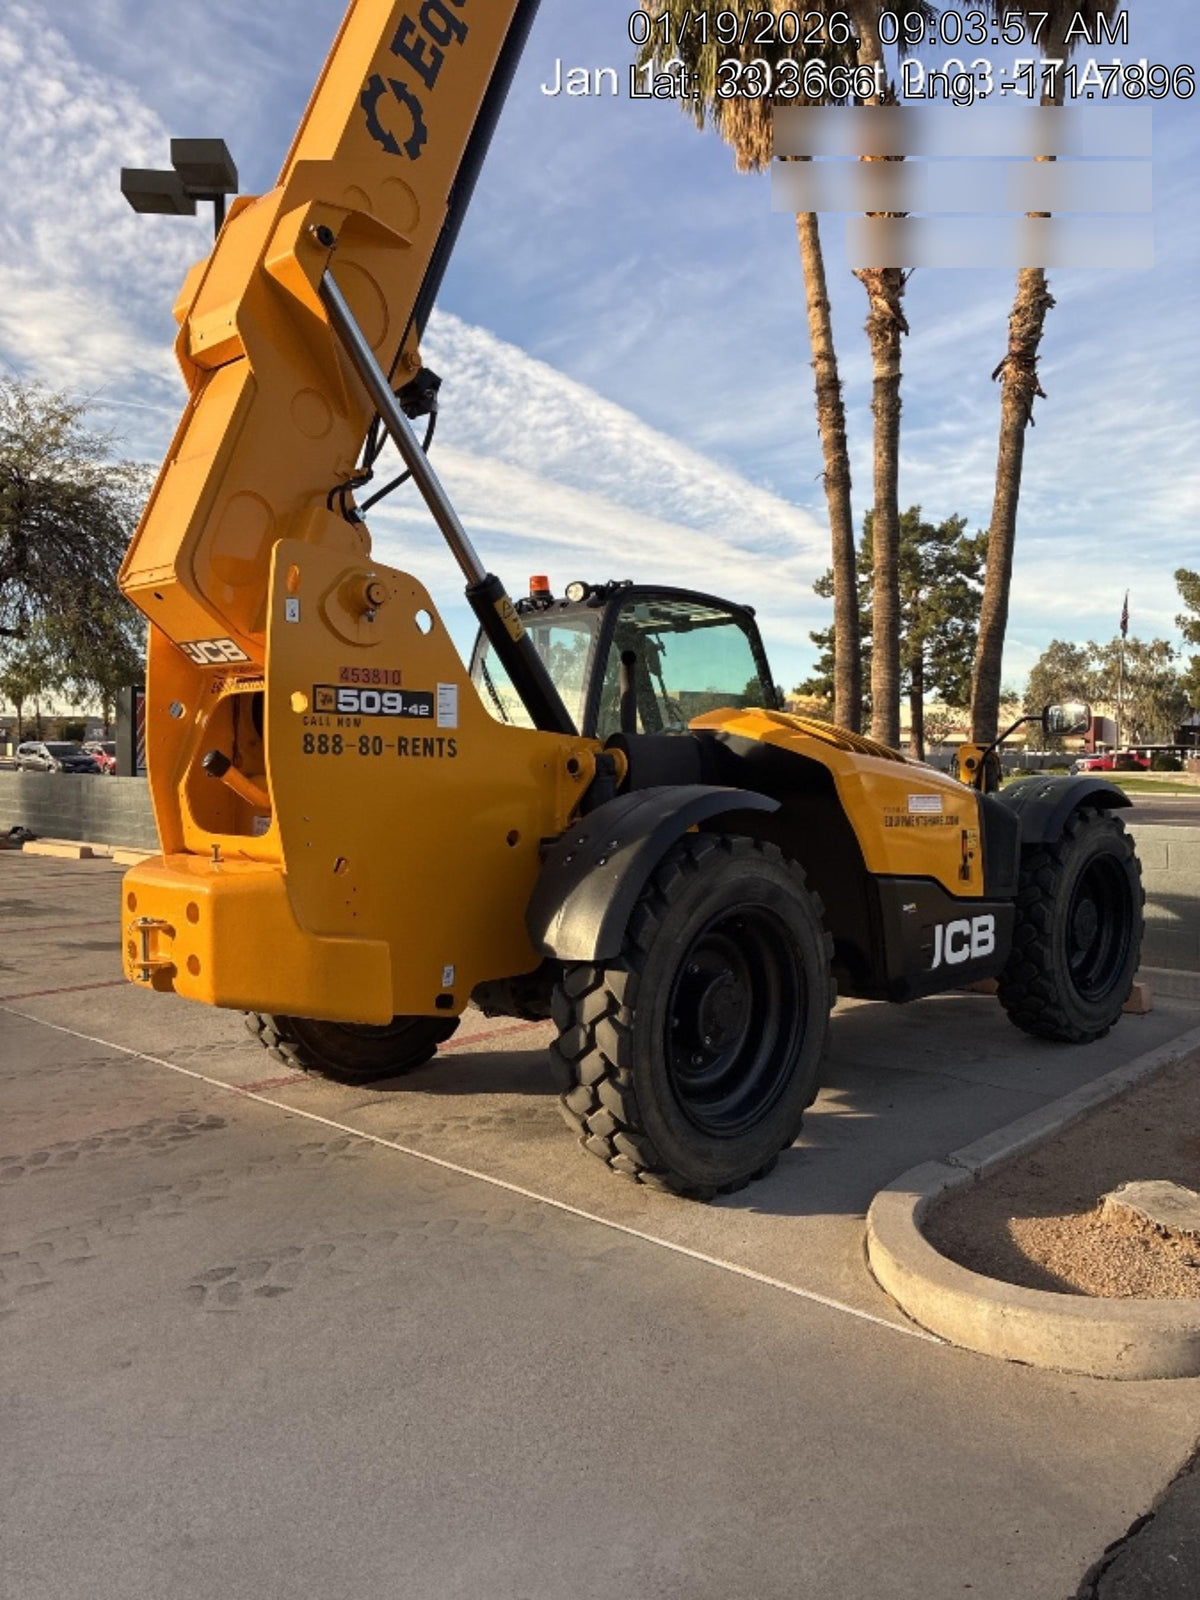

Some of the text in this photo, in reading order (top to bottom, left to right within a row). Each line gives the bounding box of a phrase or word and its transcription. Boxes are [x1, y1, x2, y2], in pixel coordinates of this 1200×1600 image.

[180, 640, 248, 664] JCB
[340, 667, 401, 685] 453810
[303, 717, 361, 727] CALL NOW
[303, 733, 458, 758] 888-80-RENTS
[931, 913, 995, 969] JCB
